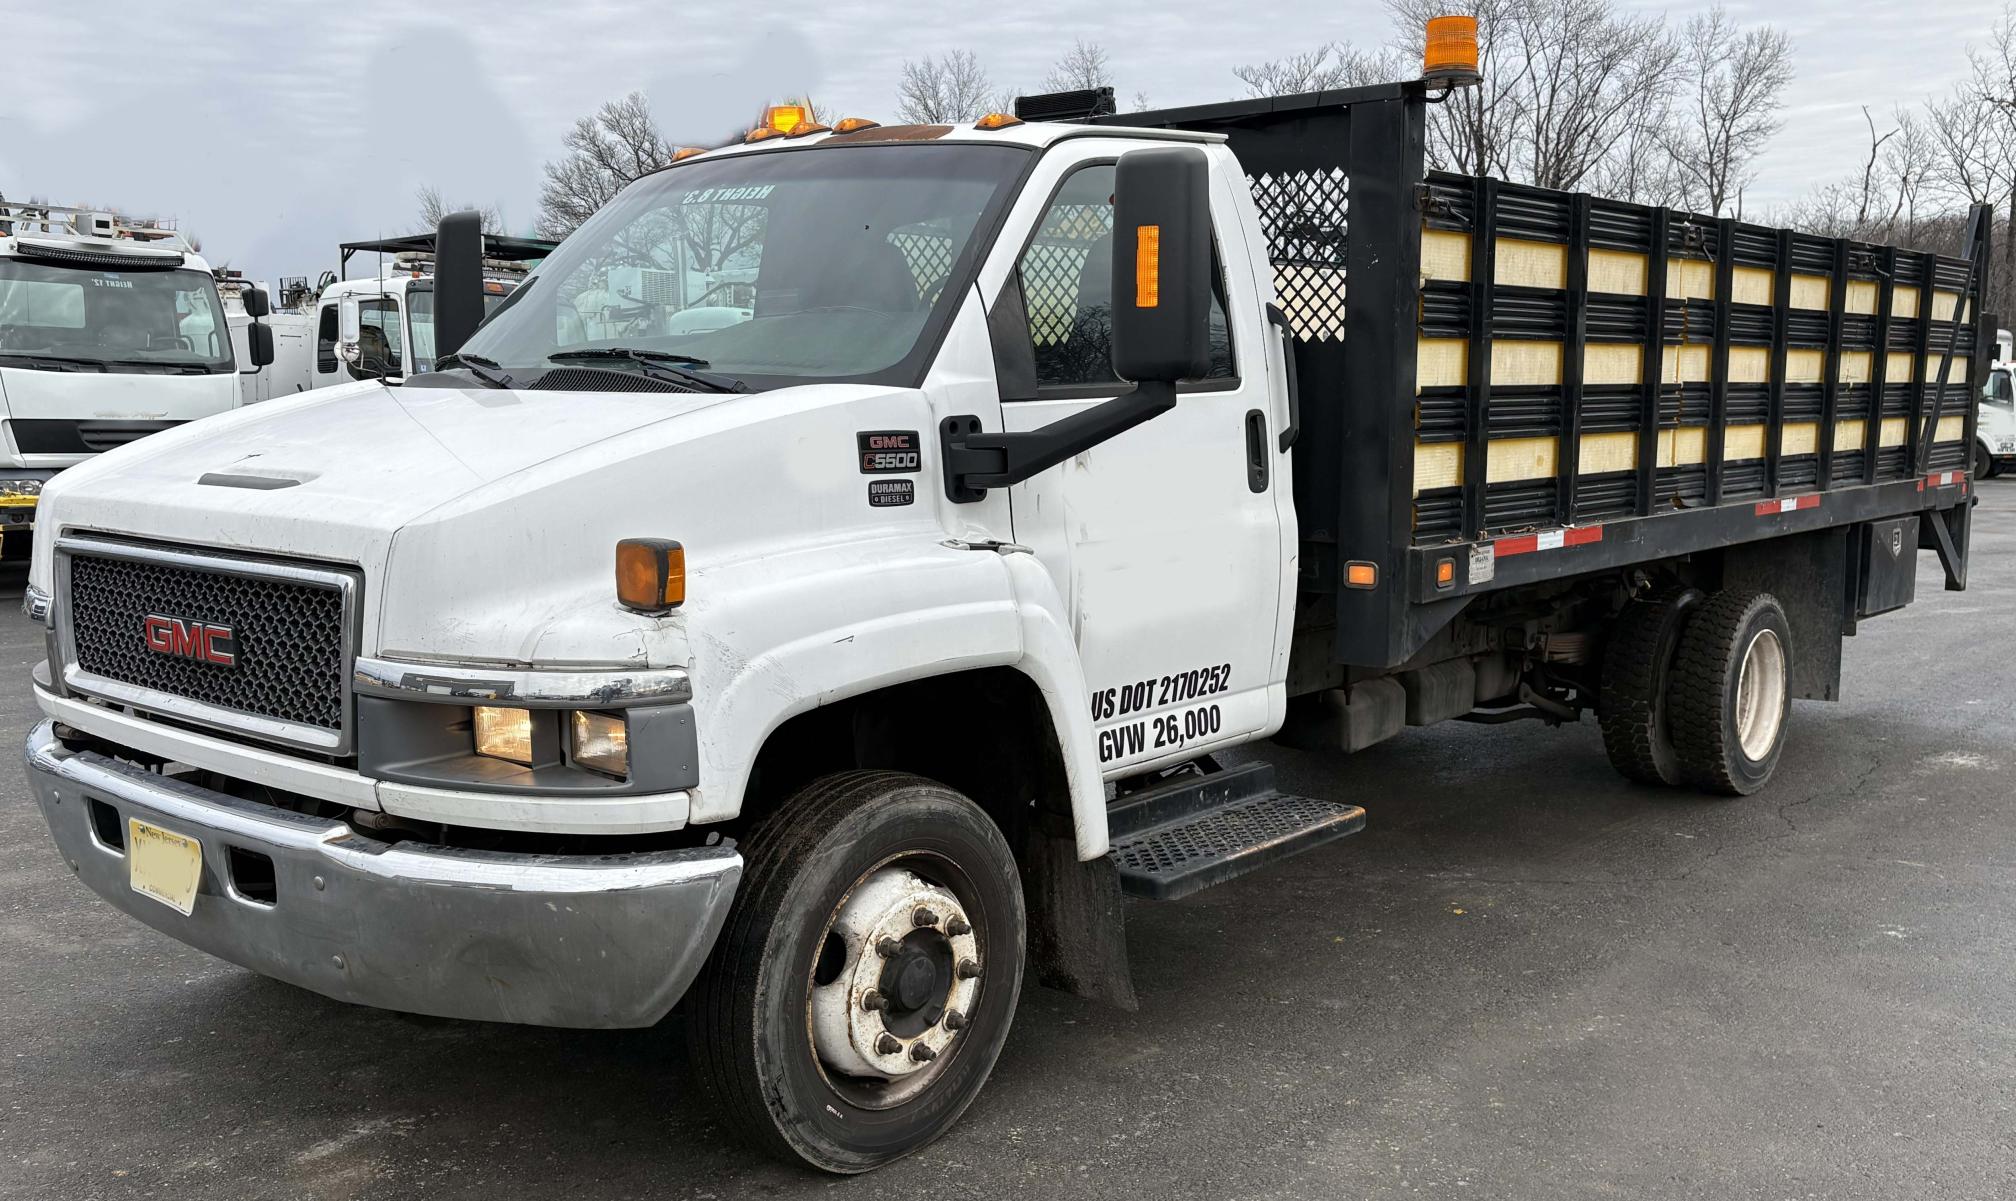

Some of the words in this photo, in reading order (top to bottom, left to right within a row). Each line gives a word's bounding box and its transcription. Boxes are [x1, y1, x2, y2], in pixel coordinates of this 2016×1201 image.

[869, 435, 910, 449] GMC
[863, 452, 918, 469] C5500
[871, 483, 912, 494] DURAMAX
[880, 494, 905, 503] DIESEL
[144, 614, 235, 666] GMC
[1091, 688, 1117, 722] US
[1119, 678, 1158, 716] DOT
[1158, 663, 1232, 706] 2170252
[1098, 722, 1146, 763] GVW
[1153, 704, 1222, 749] 26,000
[145, 826, 161, 840] New
[161, 831, 182, 847] Jersey
